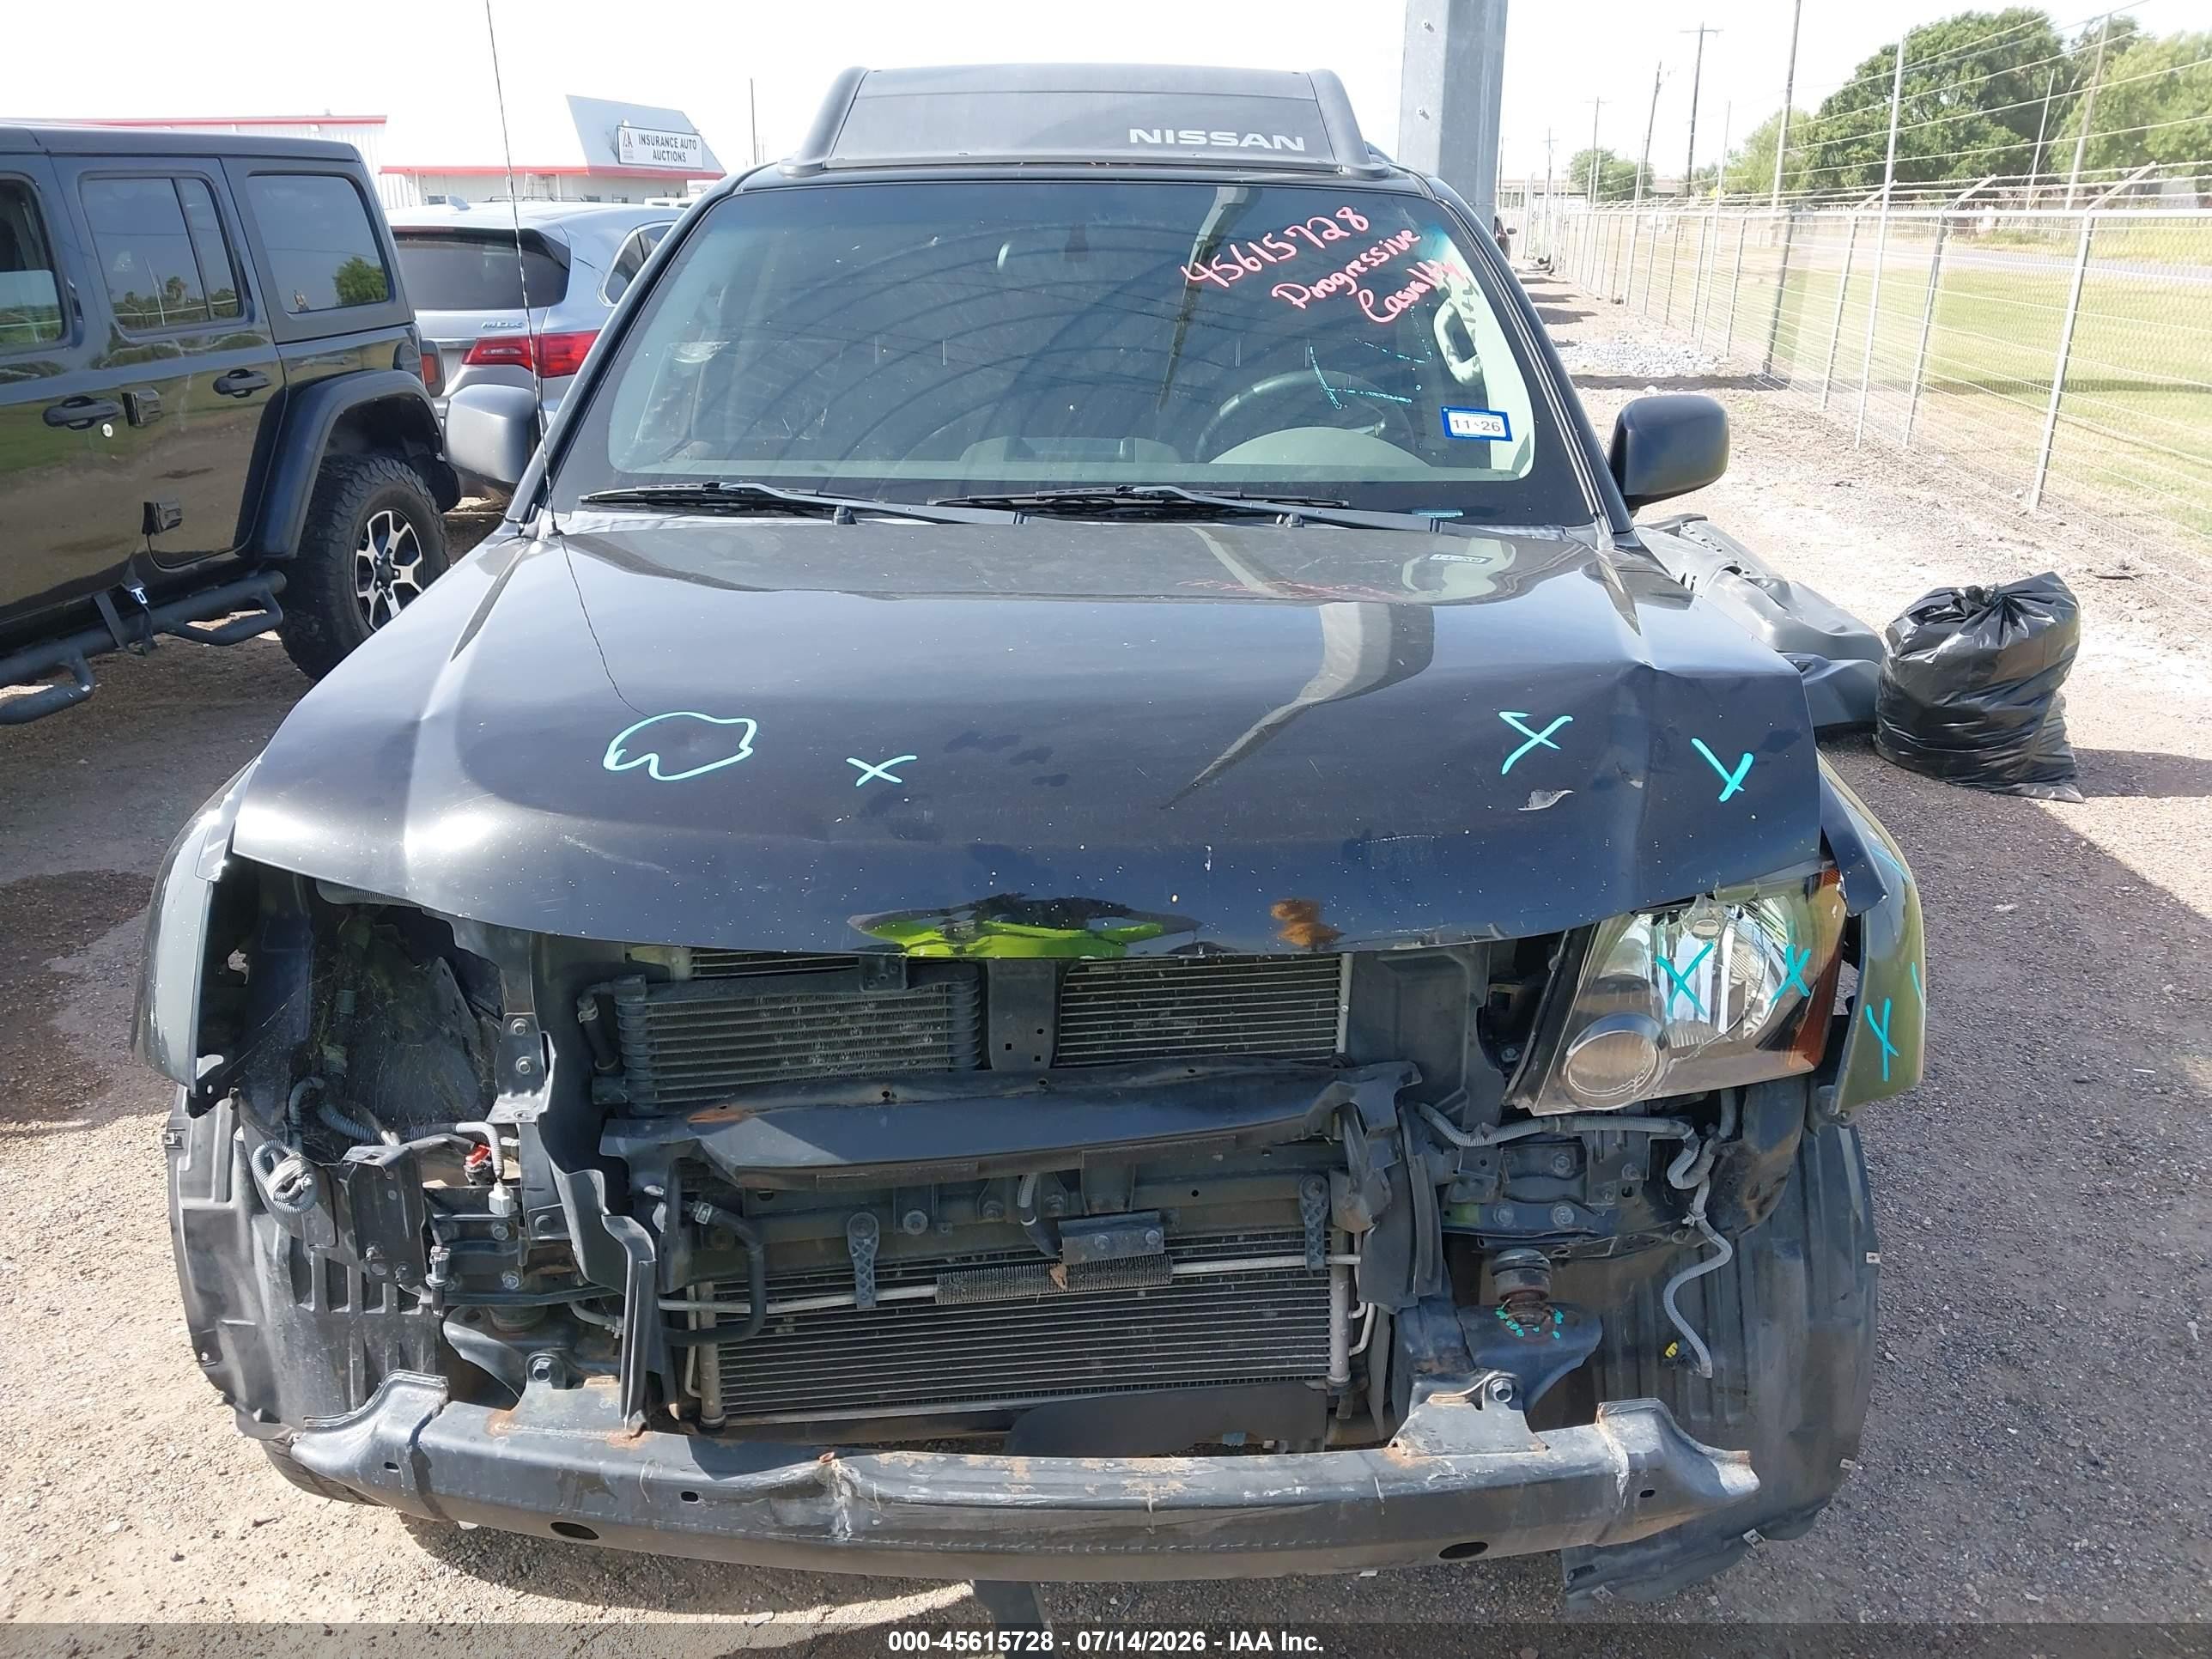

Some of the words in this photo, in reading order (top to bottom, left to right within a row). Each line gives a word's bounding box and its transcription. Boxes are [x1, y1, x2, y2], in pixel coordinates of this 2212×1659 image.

[638, 133, 678, 149] INSURANCE
[680, 137, 697, 150] AUTO
[1129, 129, 1305, 152] NISSAN
[653, 149, 687, 163] AUCTIONS
[1181, 206, 1370, 289] 45615728
[1272, 228, 1422, 309] Progressive
